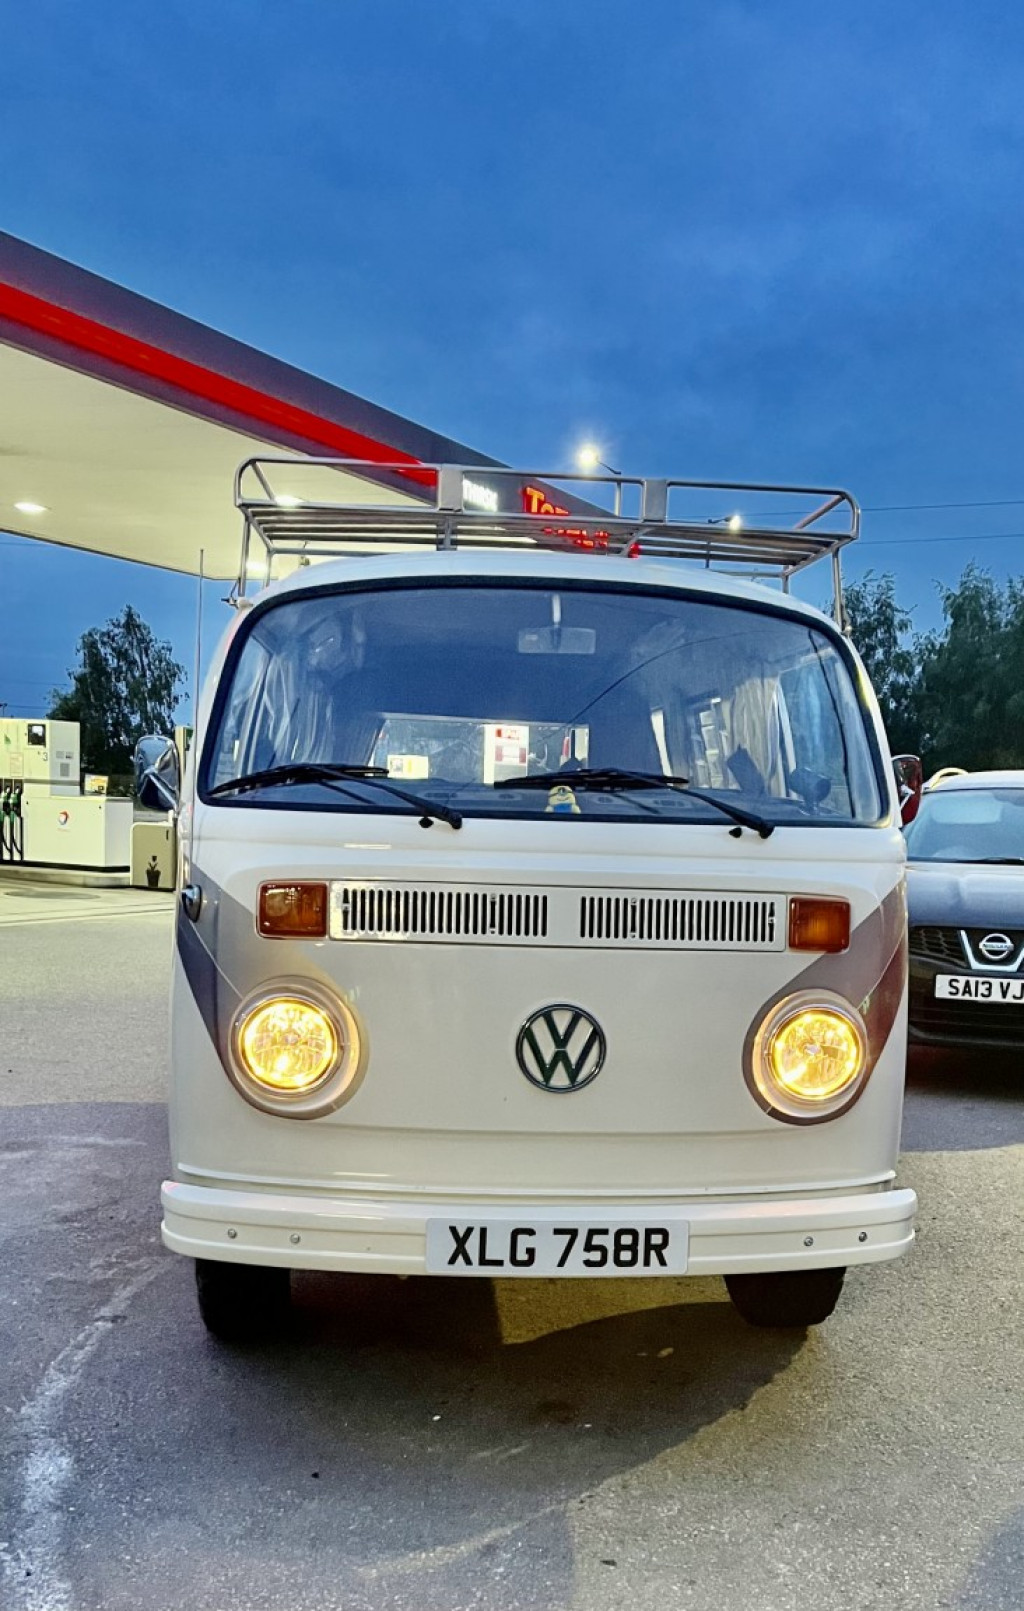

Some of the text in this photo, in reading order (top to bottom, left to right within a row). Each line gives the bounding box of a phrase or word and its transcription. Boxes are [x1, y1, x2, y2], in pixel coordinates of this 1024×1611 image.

[948, 978, 1024, 1000] SA13 VJ
[523, 1009, 600, 1088] VW
[447, 1225, 670, 1268] XLG 758R
